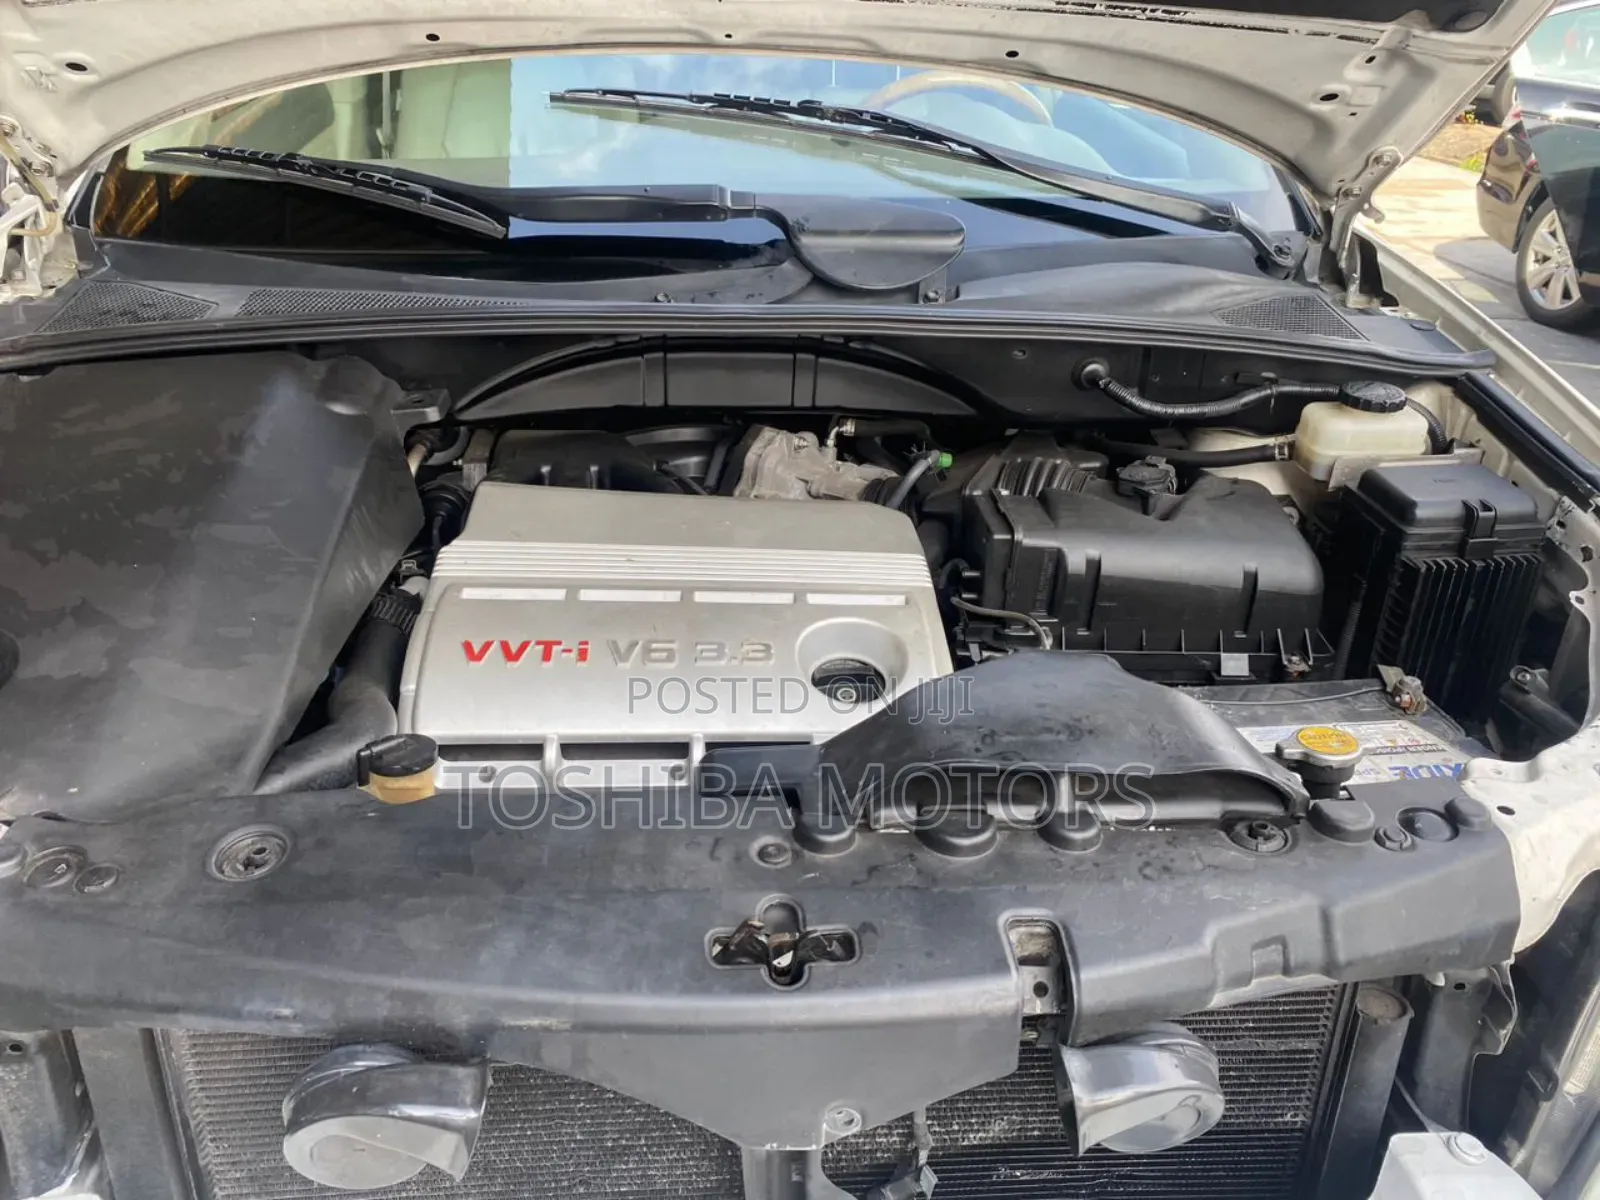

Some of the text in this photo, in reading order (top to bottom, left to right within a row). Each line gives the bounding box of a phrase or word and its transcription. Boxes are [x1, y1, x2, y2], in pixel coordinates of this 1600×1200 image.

[461, 640, 775, 667] VVT-i V6 3.3
